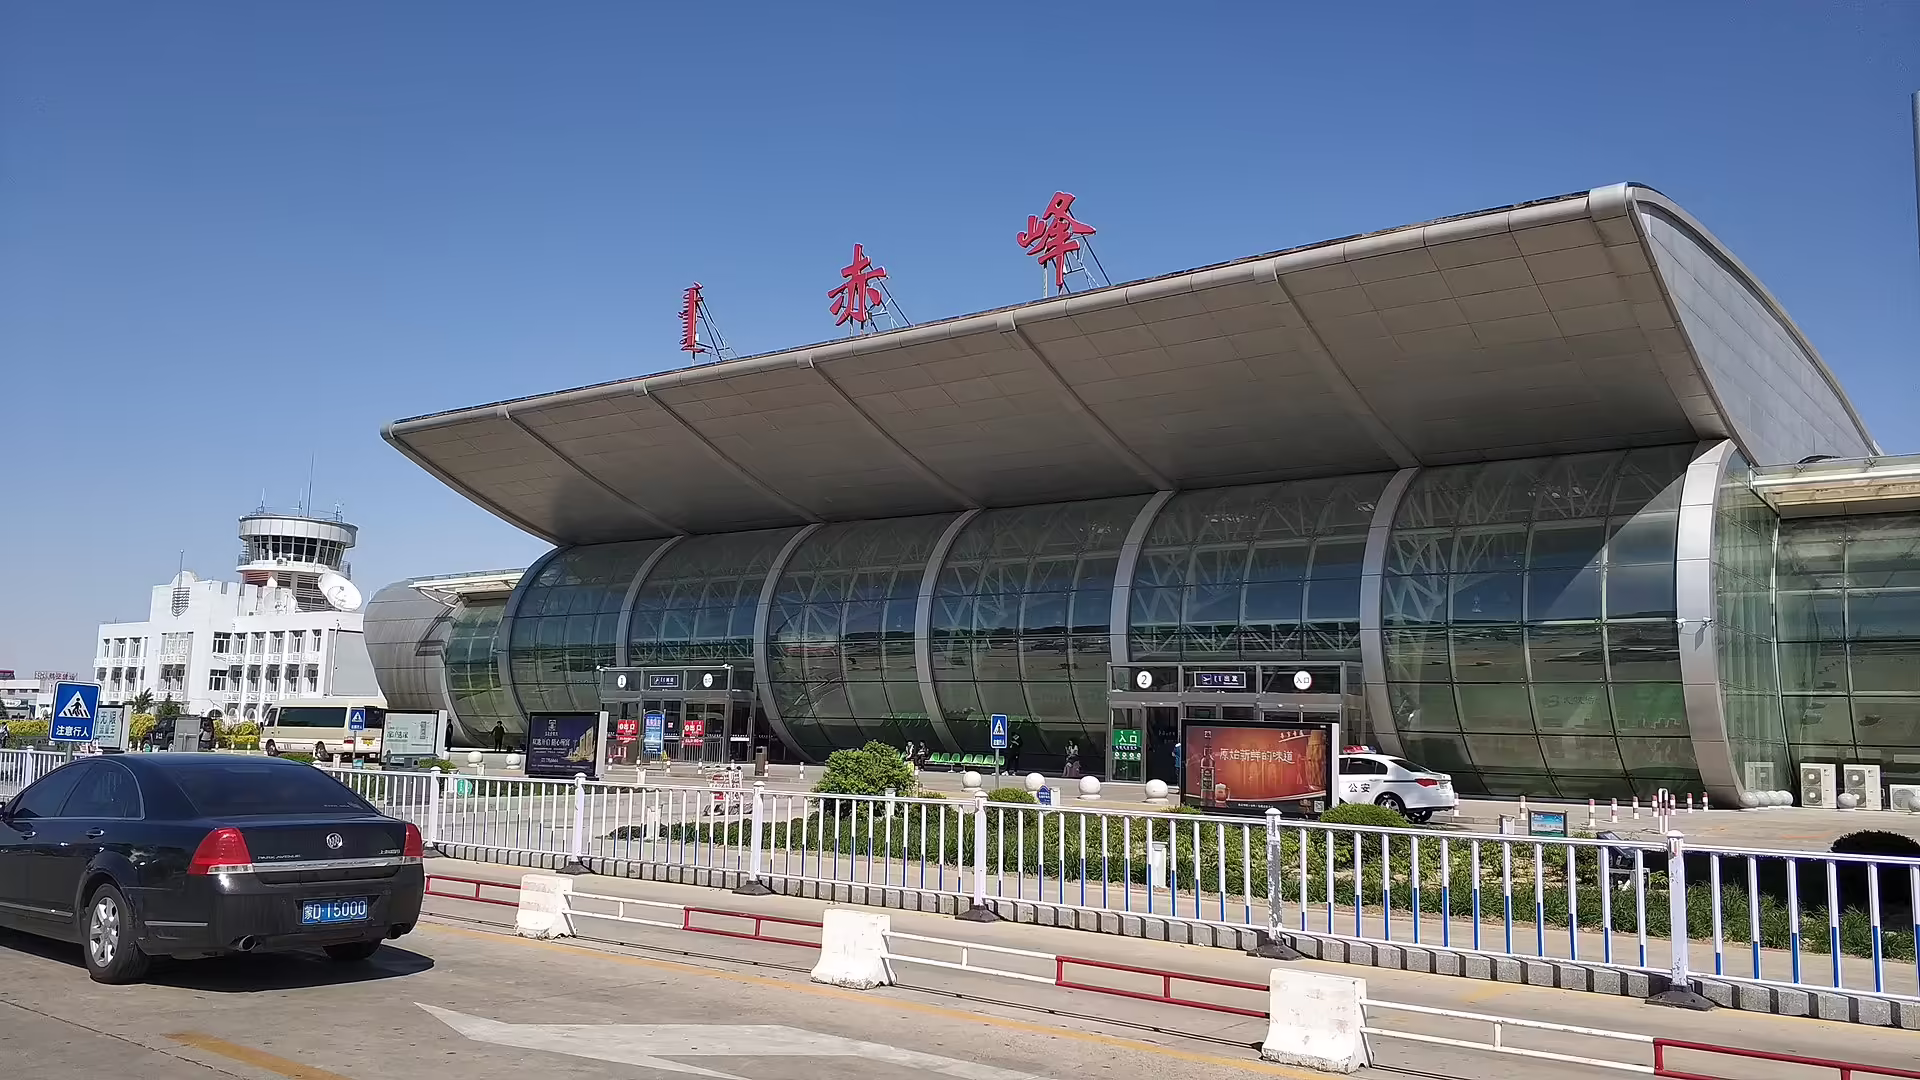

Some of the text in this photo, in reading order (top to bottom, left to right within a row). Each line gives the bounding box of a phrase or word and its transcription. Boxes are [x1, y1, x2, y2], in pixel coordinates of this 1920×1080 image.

[1141, 674, 1147, 685] 2
[56, 725, 89, 738] 注意行人
[1119, 735, 1137, 743] 入口
[1220, 747, 1295, 764] 原始新鲜的味道
[1348, 783, 1370, 793] 公安
